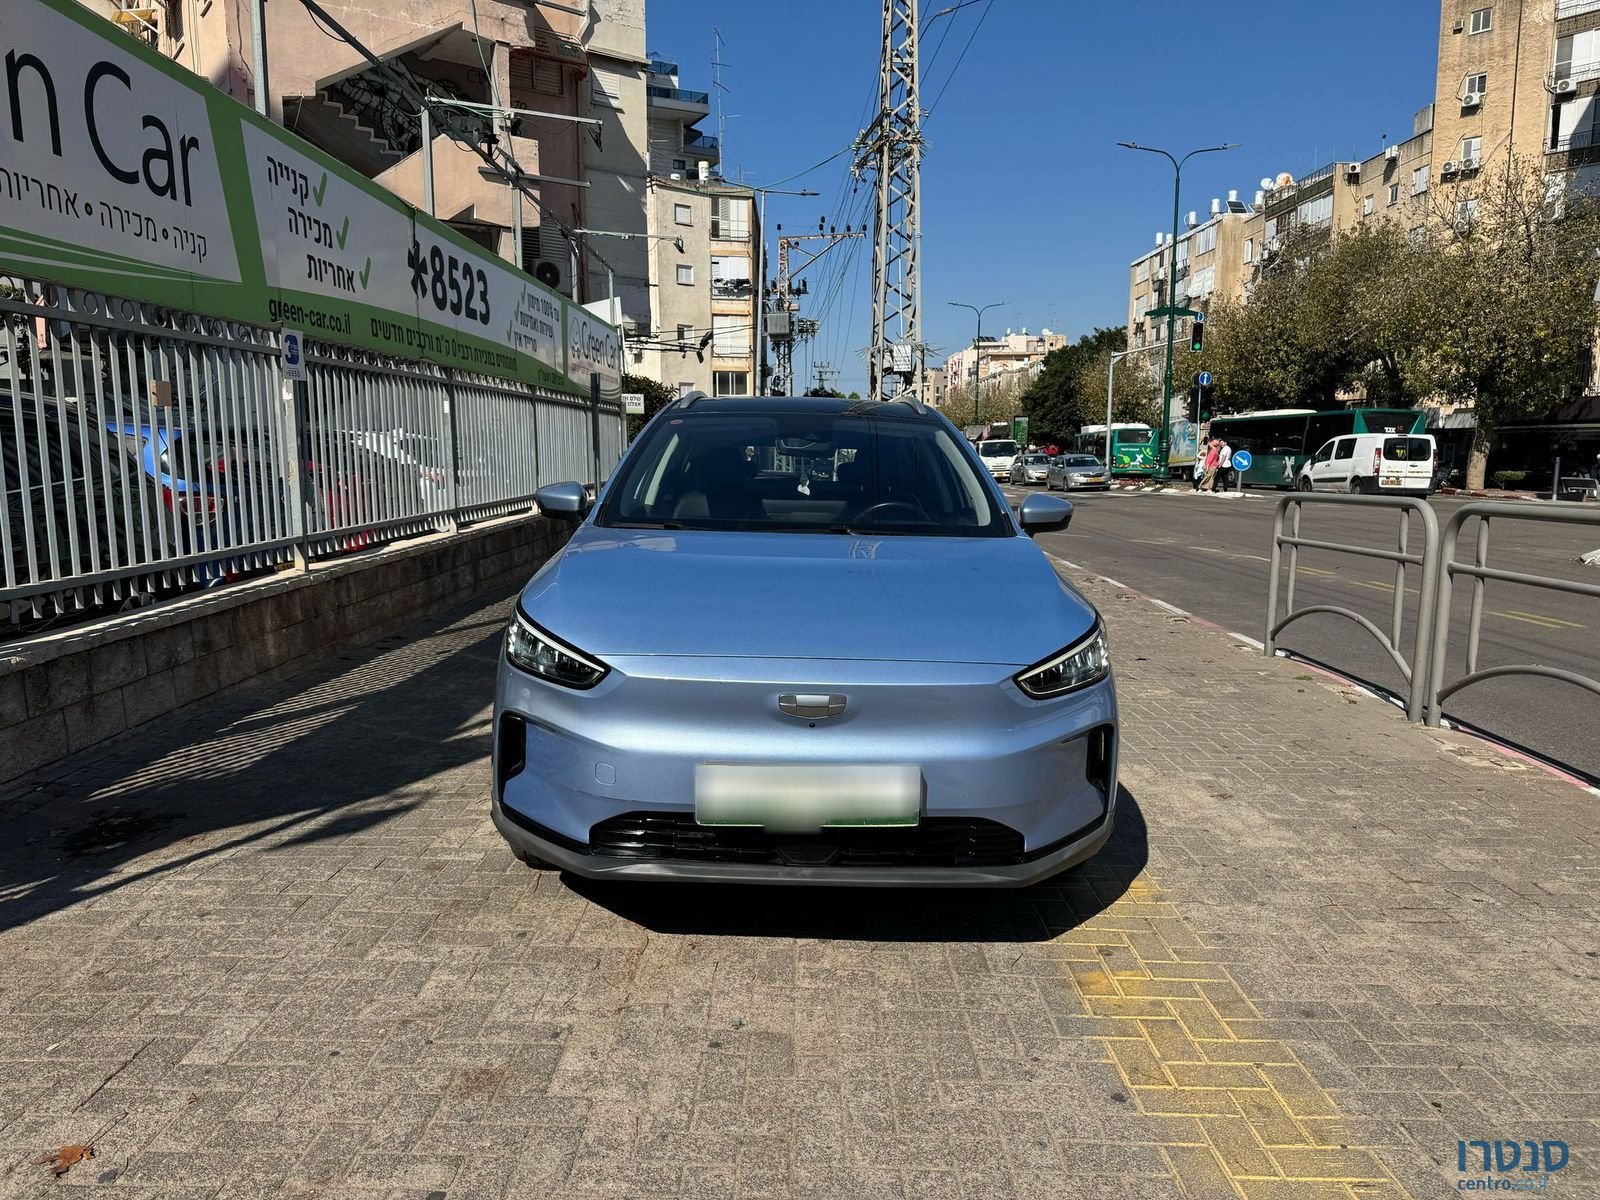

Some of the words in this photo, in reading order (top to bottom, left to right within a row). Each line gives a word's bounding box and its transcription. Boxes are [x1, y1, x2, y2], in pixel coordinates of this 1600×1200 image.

[84, 61, 199, 206] Car
[0, 167, 80, 219] אחריות
[266, 155, 309, 206] קנייה
[100, 201, 157, 242] מכירה
[288, 206, 333, 249] מכירה
[173, 226, 207, 263] קניה
[307, 254, 355, 293] אחריות
[269, 299, 351, 335] green-car.co.il
[370, 318, 405, 344] חדשים
[406, 327, 434, 351] ורכבים
[582, 320, 605, 364] Green
[605, 333, 617, 369] Car
